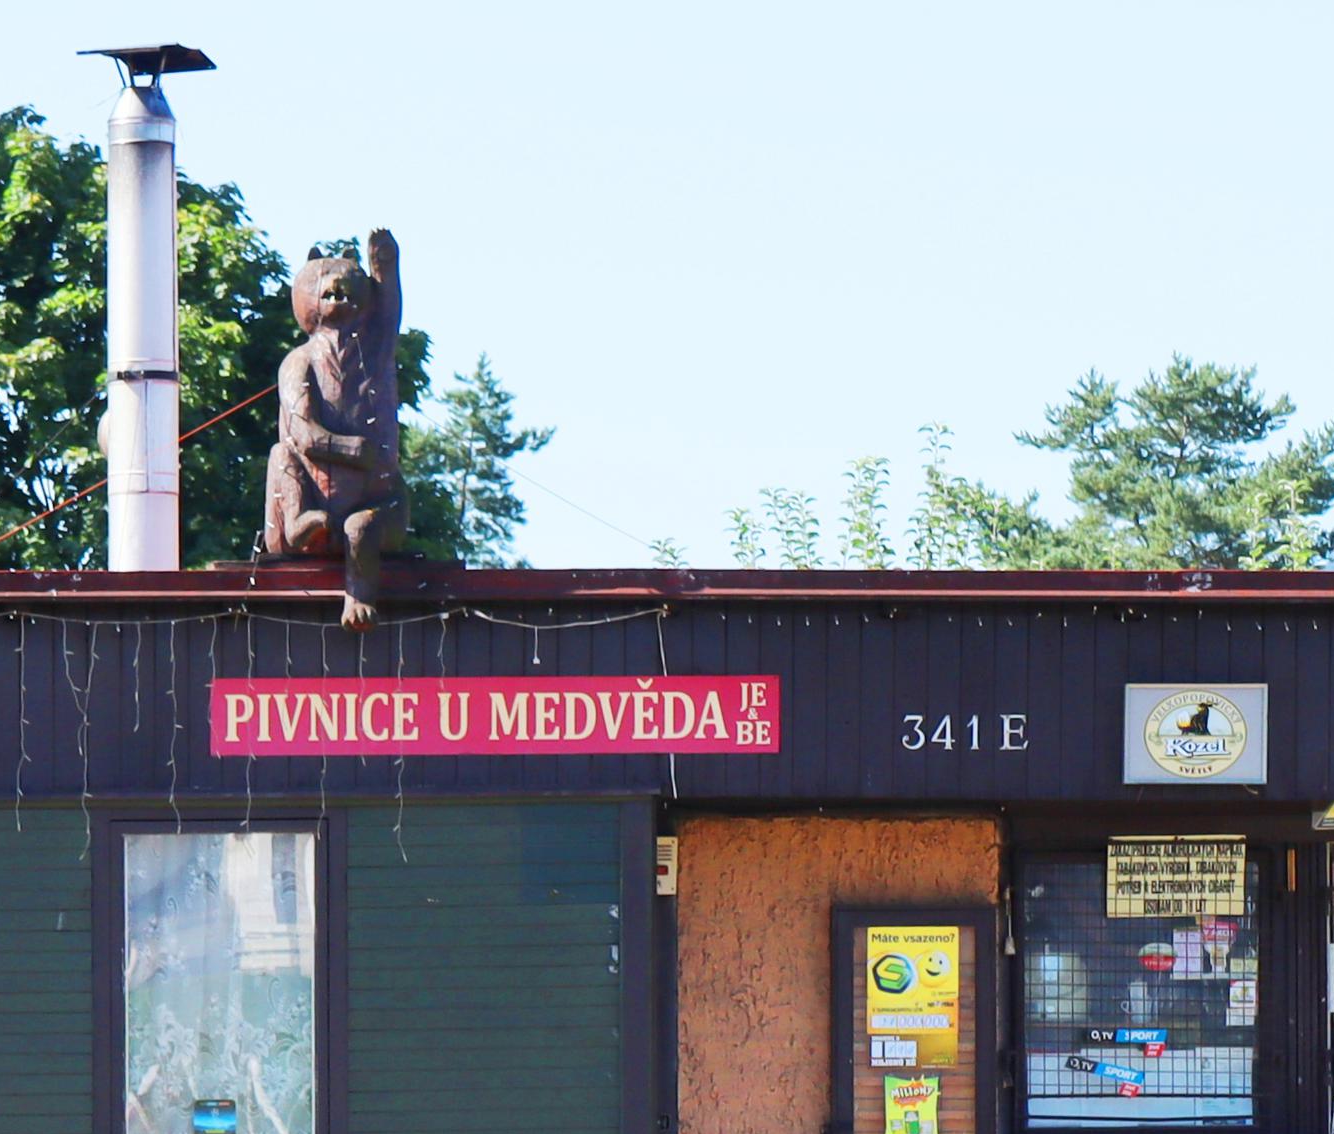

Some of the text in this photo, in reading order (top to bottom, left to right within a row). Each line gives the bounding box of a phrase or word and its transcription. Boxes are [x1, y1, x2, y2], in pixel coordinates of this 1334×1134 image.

[738, 683, 768, 708] JE
[224, 678, 729, 742] PIVNICE U MEDVĚDA
[735, 720, 771, 745] BE
[1164, 737, 1233, 758] Kozel
[871, 931, 955, 944] Máte vsazeno?
[1124, 1031, 1159, 1040] SPORT
[1104, 1066, 1138, 1081] SPORT
